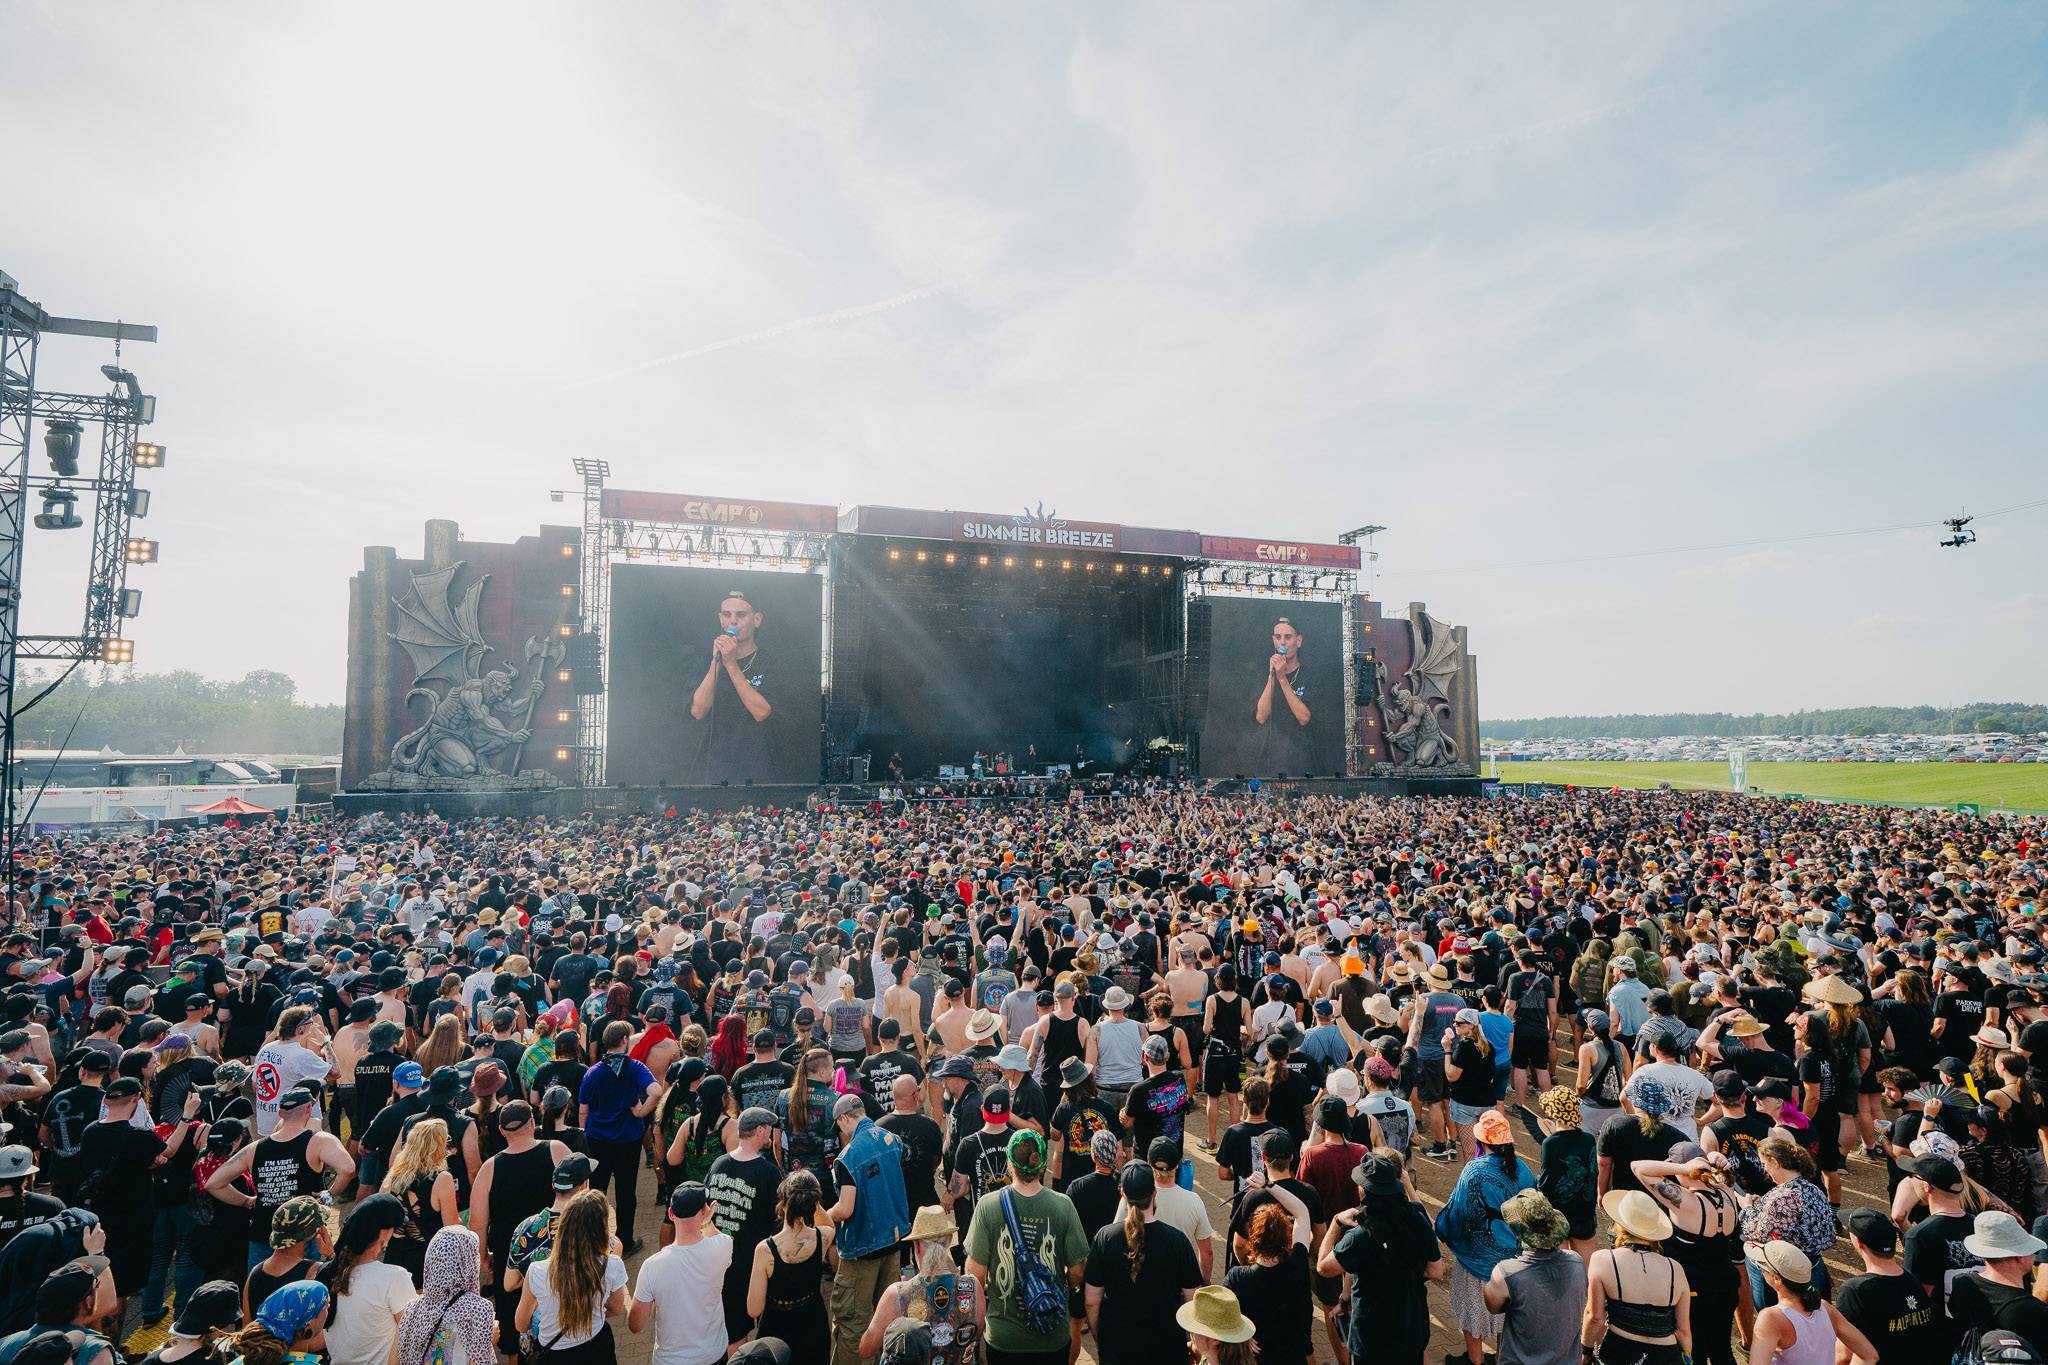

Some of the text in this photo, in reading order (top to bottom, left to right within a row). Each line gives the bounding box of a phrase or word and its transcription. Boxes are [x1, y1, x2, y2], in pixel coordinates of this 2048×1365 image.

[683, 501, 744, 522] EMP
[963, 522, 1114, 548] SUMMER BREEZE
[1255, 544, 1297, 561] EMP
[257, 1163, 300, 1173] VULNERABLE
[280, 1169, 297, 1177] NOW
[273, 1175, 288, 1183] ANY
[275, 1179, 298, 1187] GIRLS
[280, 1184, 298, 1192] LIKE
[271, 1190, 291, 1198] TAKE
